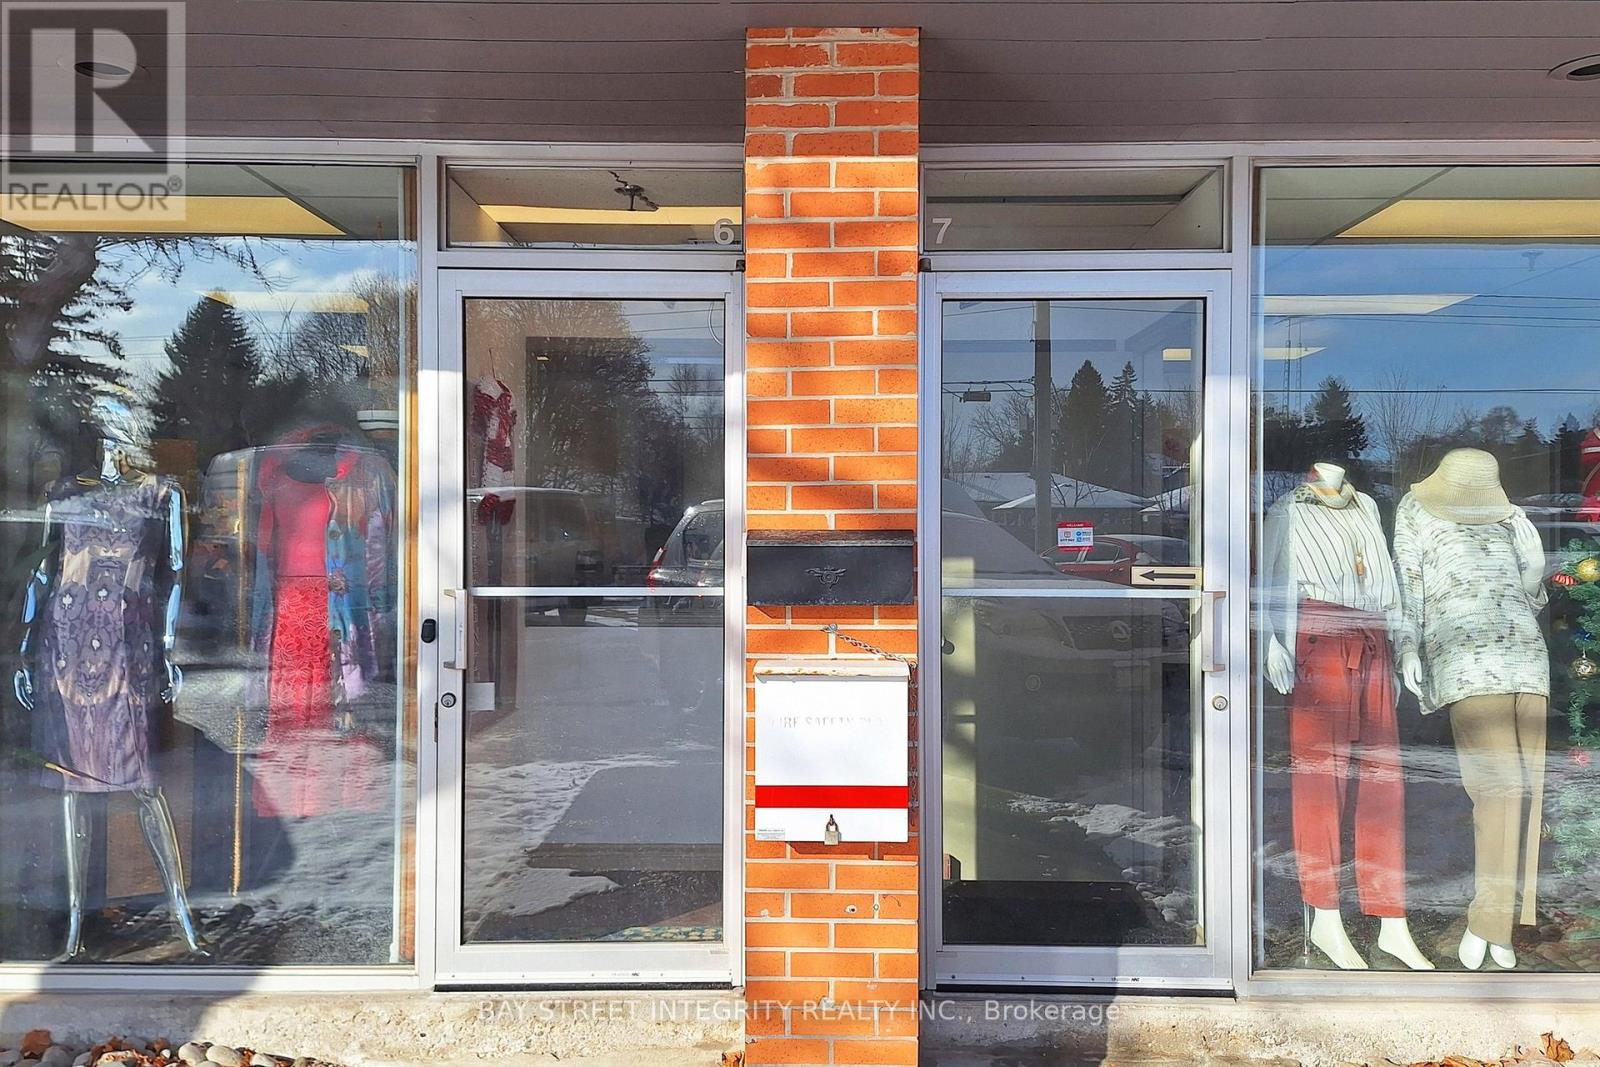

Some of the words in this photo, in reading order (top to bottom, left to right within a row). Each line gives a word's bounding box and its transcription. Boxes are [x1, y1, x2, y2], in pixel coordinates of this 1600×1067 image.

[713, 218, 735, 245] 6
[932, 218, 953, 244] 7
[769, 716, 799, 728] IRE
